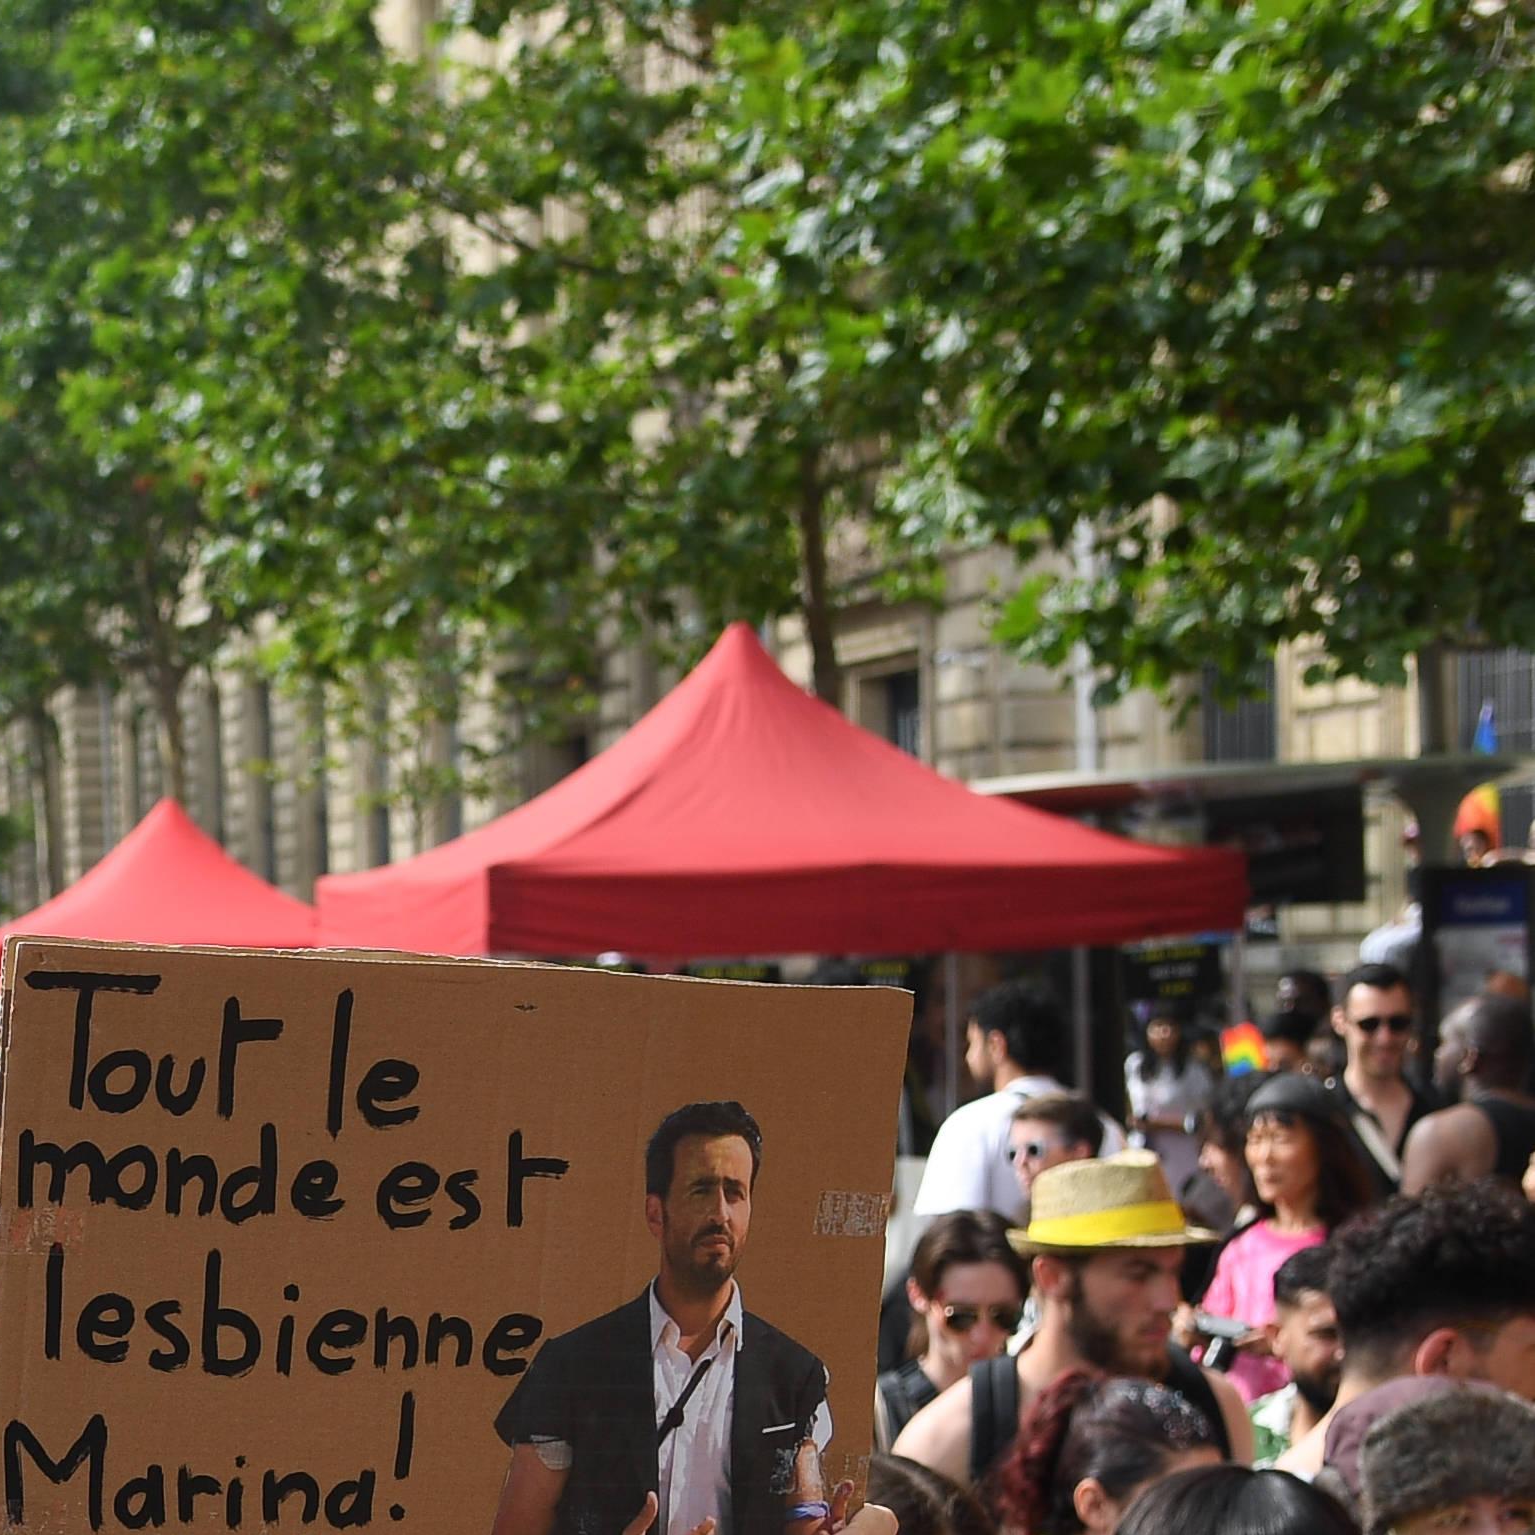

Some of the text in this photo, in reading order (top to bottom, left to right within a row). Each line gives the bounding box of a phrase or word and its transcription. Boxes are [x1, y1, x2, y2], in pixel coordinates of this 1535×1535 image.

[26, 971, 421, 1138] Tout le
[17, 1123, 570, 1230] monde est
[43, 1243, 544, 1377] lesbienne
[3, 1391, 416, 1532] Marina!
